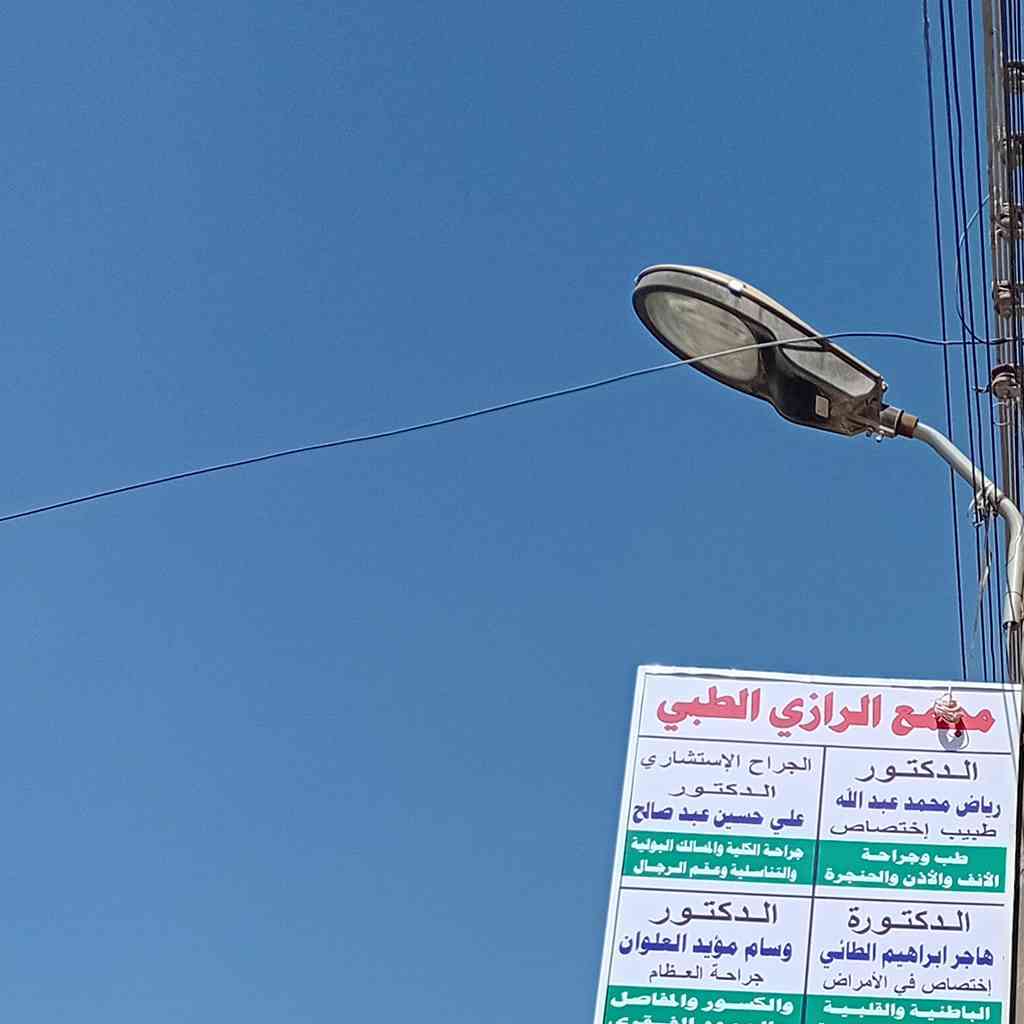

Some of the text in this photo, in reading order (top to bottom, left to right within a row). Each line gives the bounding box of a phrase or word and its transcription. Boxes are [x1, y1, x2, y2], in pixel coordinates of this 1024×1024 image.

[656, 686, 761, 732] الطبي
[768, 691, 882, 738] الرازي
[640, 750, 812, 775] الجراح الإستشاري
[855, 759, 978, 783] الدكتور
[668, 783, 776, 798] الدكتور
[836, 788, 1001, 818] رياض محمد عبد الله
[632, 801, 805, 835] علي حسين عبد صالح
[830, 820, 997, 841] طبيب إختصاص
[631, 836, 804, 860] جراحة الكلية والمسالك البولية
[861, 848, 968, 867] طب وجراحة
[633, 859, 797, 882] والتناسلية وعقم الرجال
[824, 868, 899, 886] والحنجرة
[649, 901, 777, 925] الدكتور
[848, 906, 970, 935] الدكتورة
[619, 931, 792, 962] وسام مؤيد العلوان
[819, 939, 994, 969] هاجر ابراهيم الطائي
[649, 963, 764, 986] جراحة العظام
[823, 972, 991, 996] إختصاص في الأمراض
[610, 991, 794, 1016] والكسور والمفاصل
[823, 1000, 990, 1022] الباطنية والقلبية
